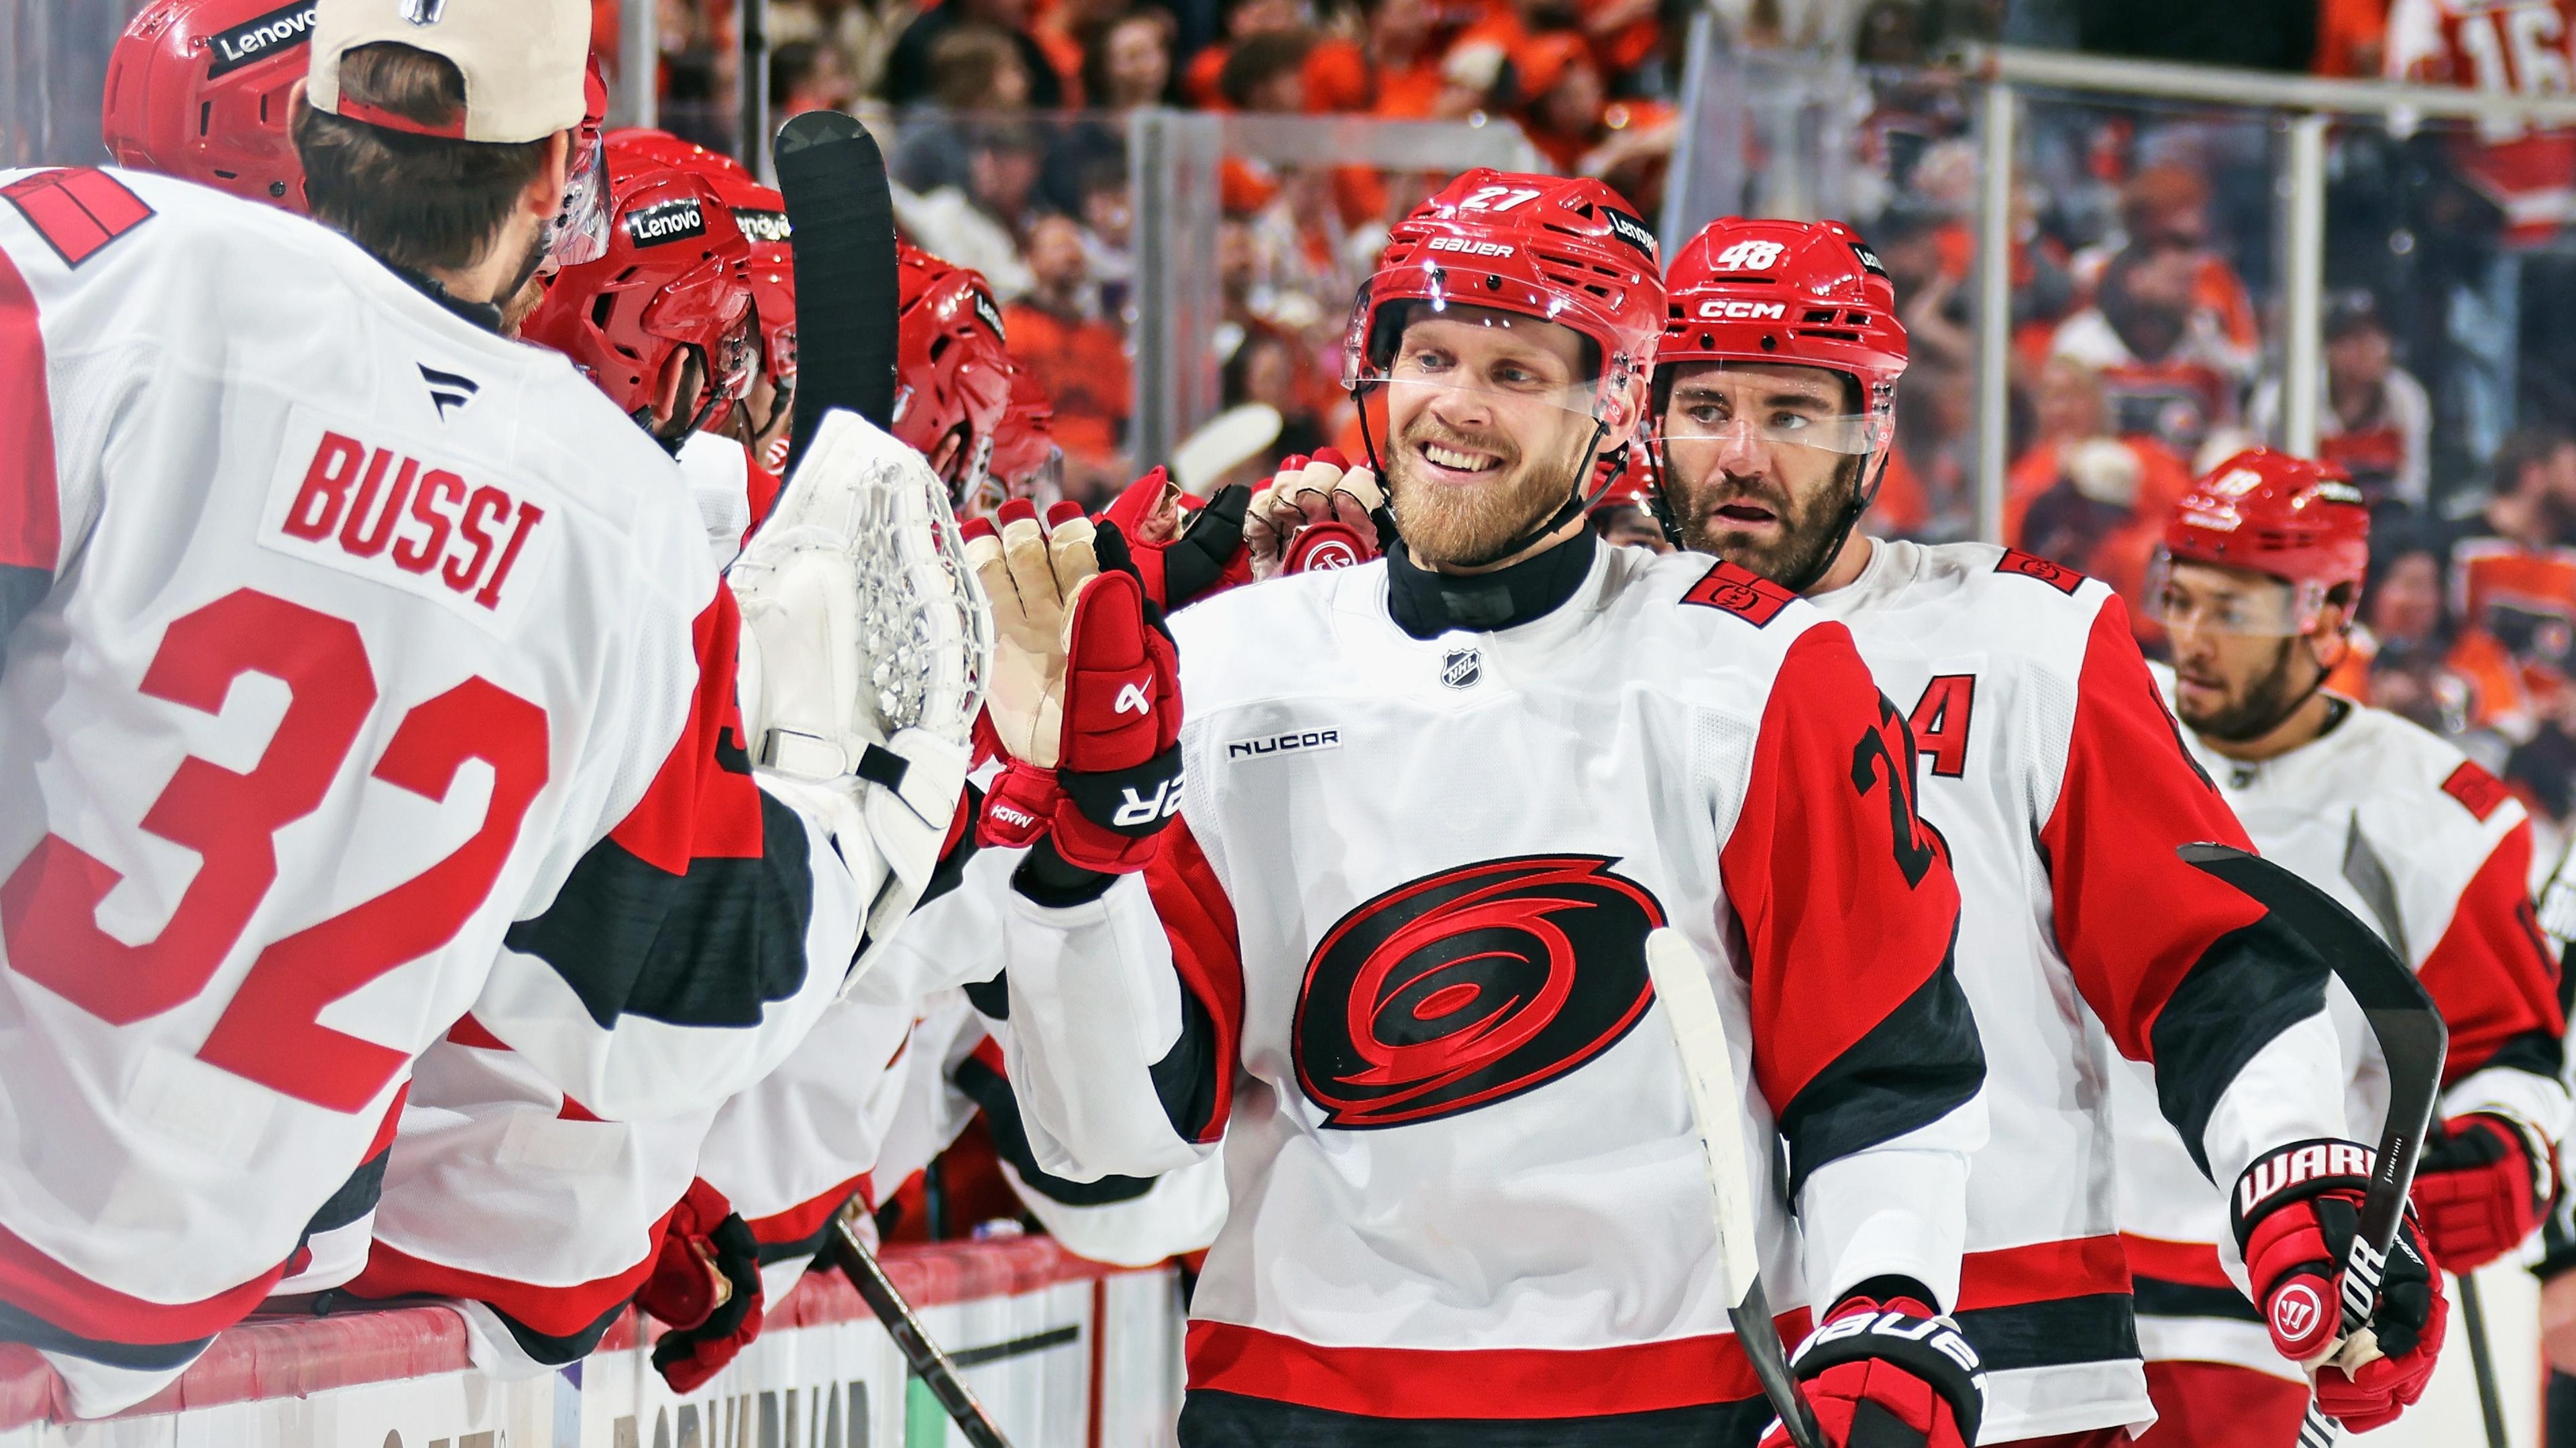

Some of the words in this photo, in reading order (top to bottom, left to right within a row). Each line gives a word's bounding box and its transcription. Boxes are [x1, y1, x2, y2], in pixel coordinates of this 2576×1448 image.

[1458, 186, 1542, 212] 27
[632, 209, 700, 239] Lenovo
[1428, 237, 1515, 258] BAUER
[1717, 239, 1786, 271] 48
[1699, 301, 1786, 320] CCM
[281, 430, 545, 611] BUSSI
[1448, 657, 1476, 683] NHL
[1907, 673, 1976, 781] A
[1229, 730, 1338, 758] NUCOR
[989, 803, 1035, 829] MACH
[0, 587, 550, 1115] 32
